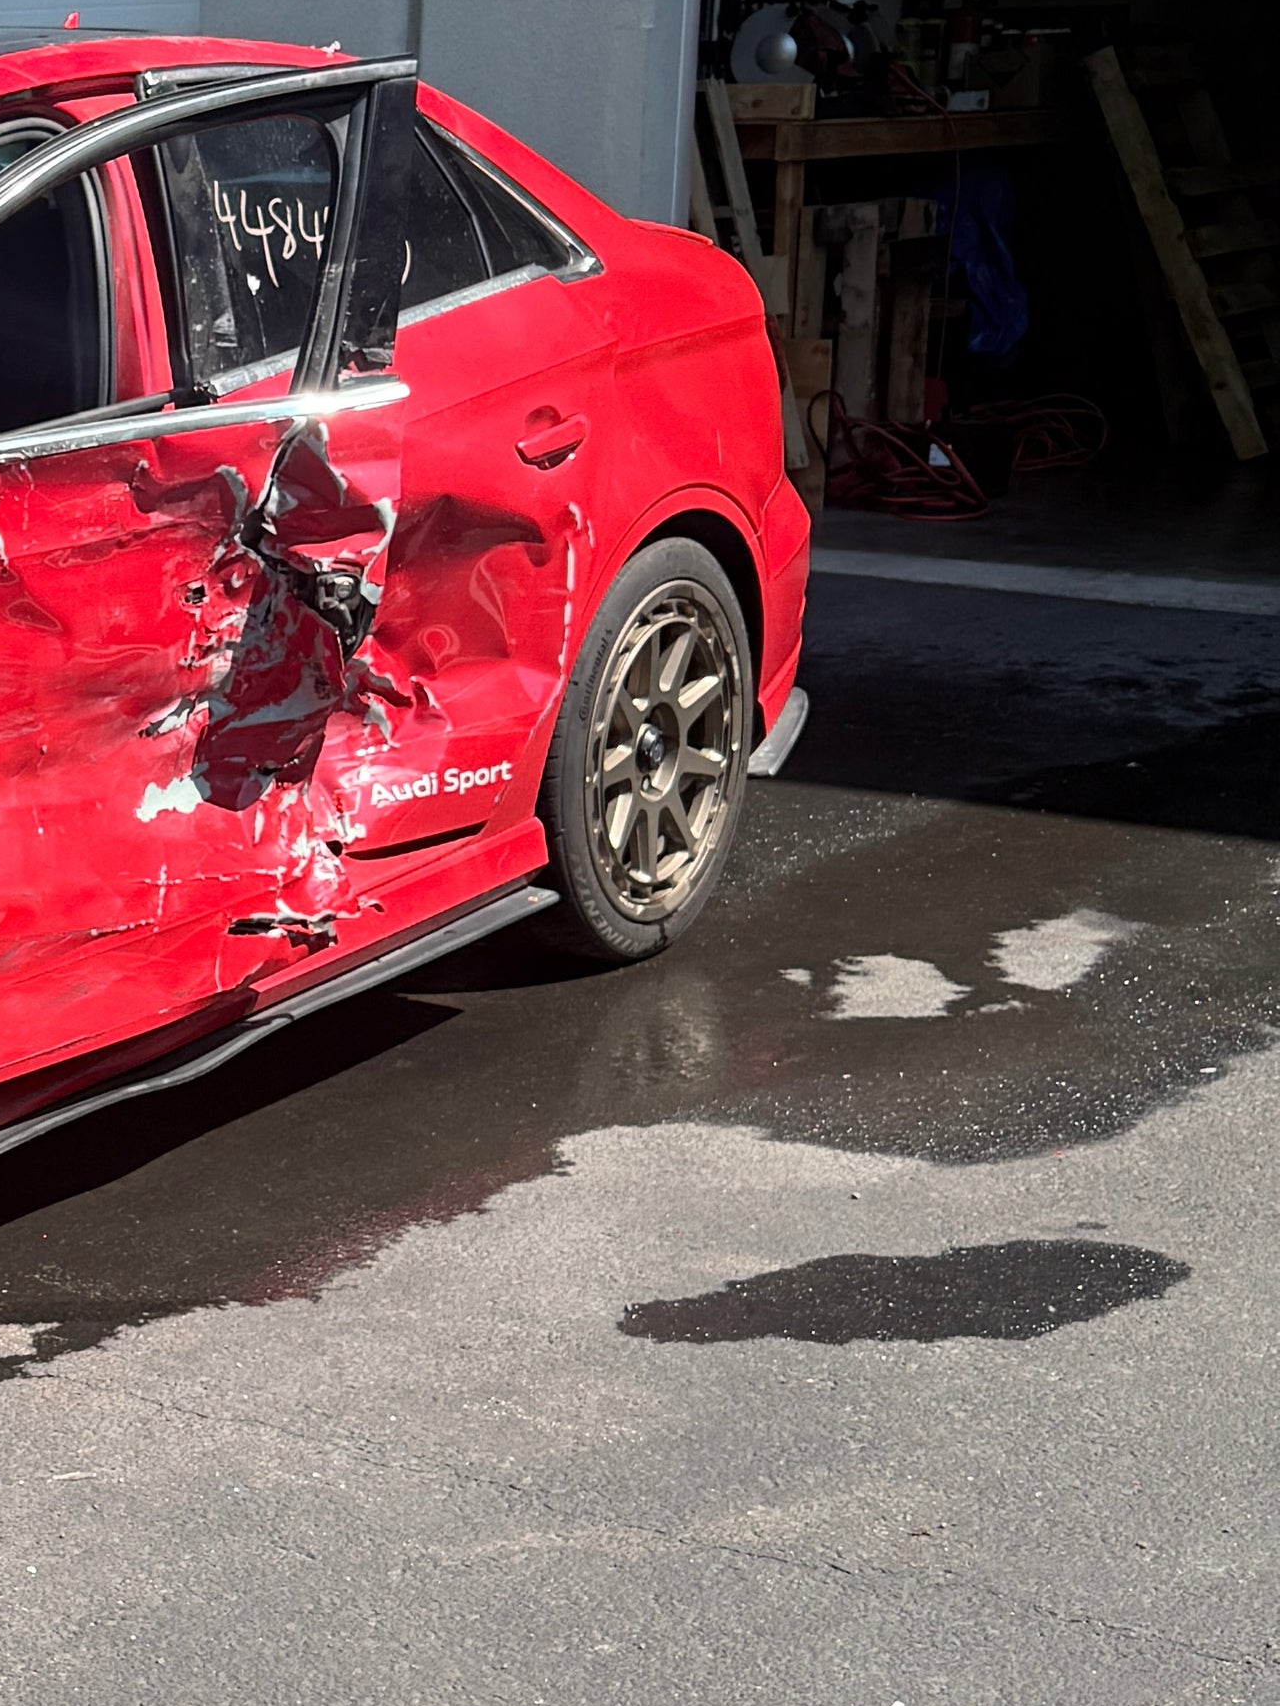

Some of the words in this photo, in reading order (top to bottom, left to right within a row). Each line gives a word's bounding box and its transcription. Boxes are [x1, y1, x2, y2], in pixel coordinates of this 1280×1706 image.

[213, 180, 329, 288] 4484
[370, 771, 438, 807] Audi
[443, 760, 513, 795] Sport
